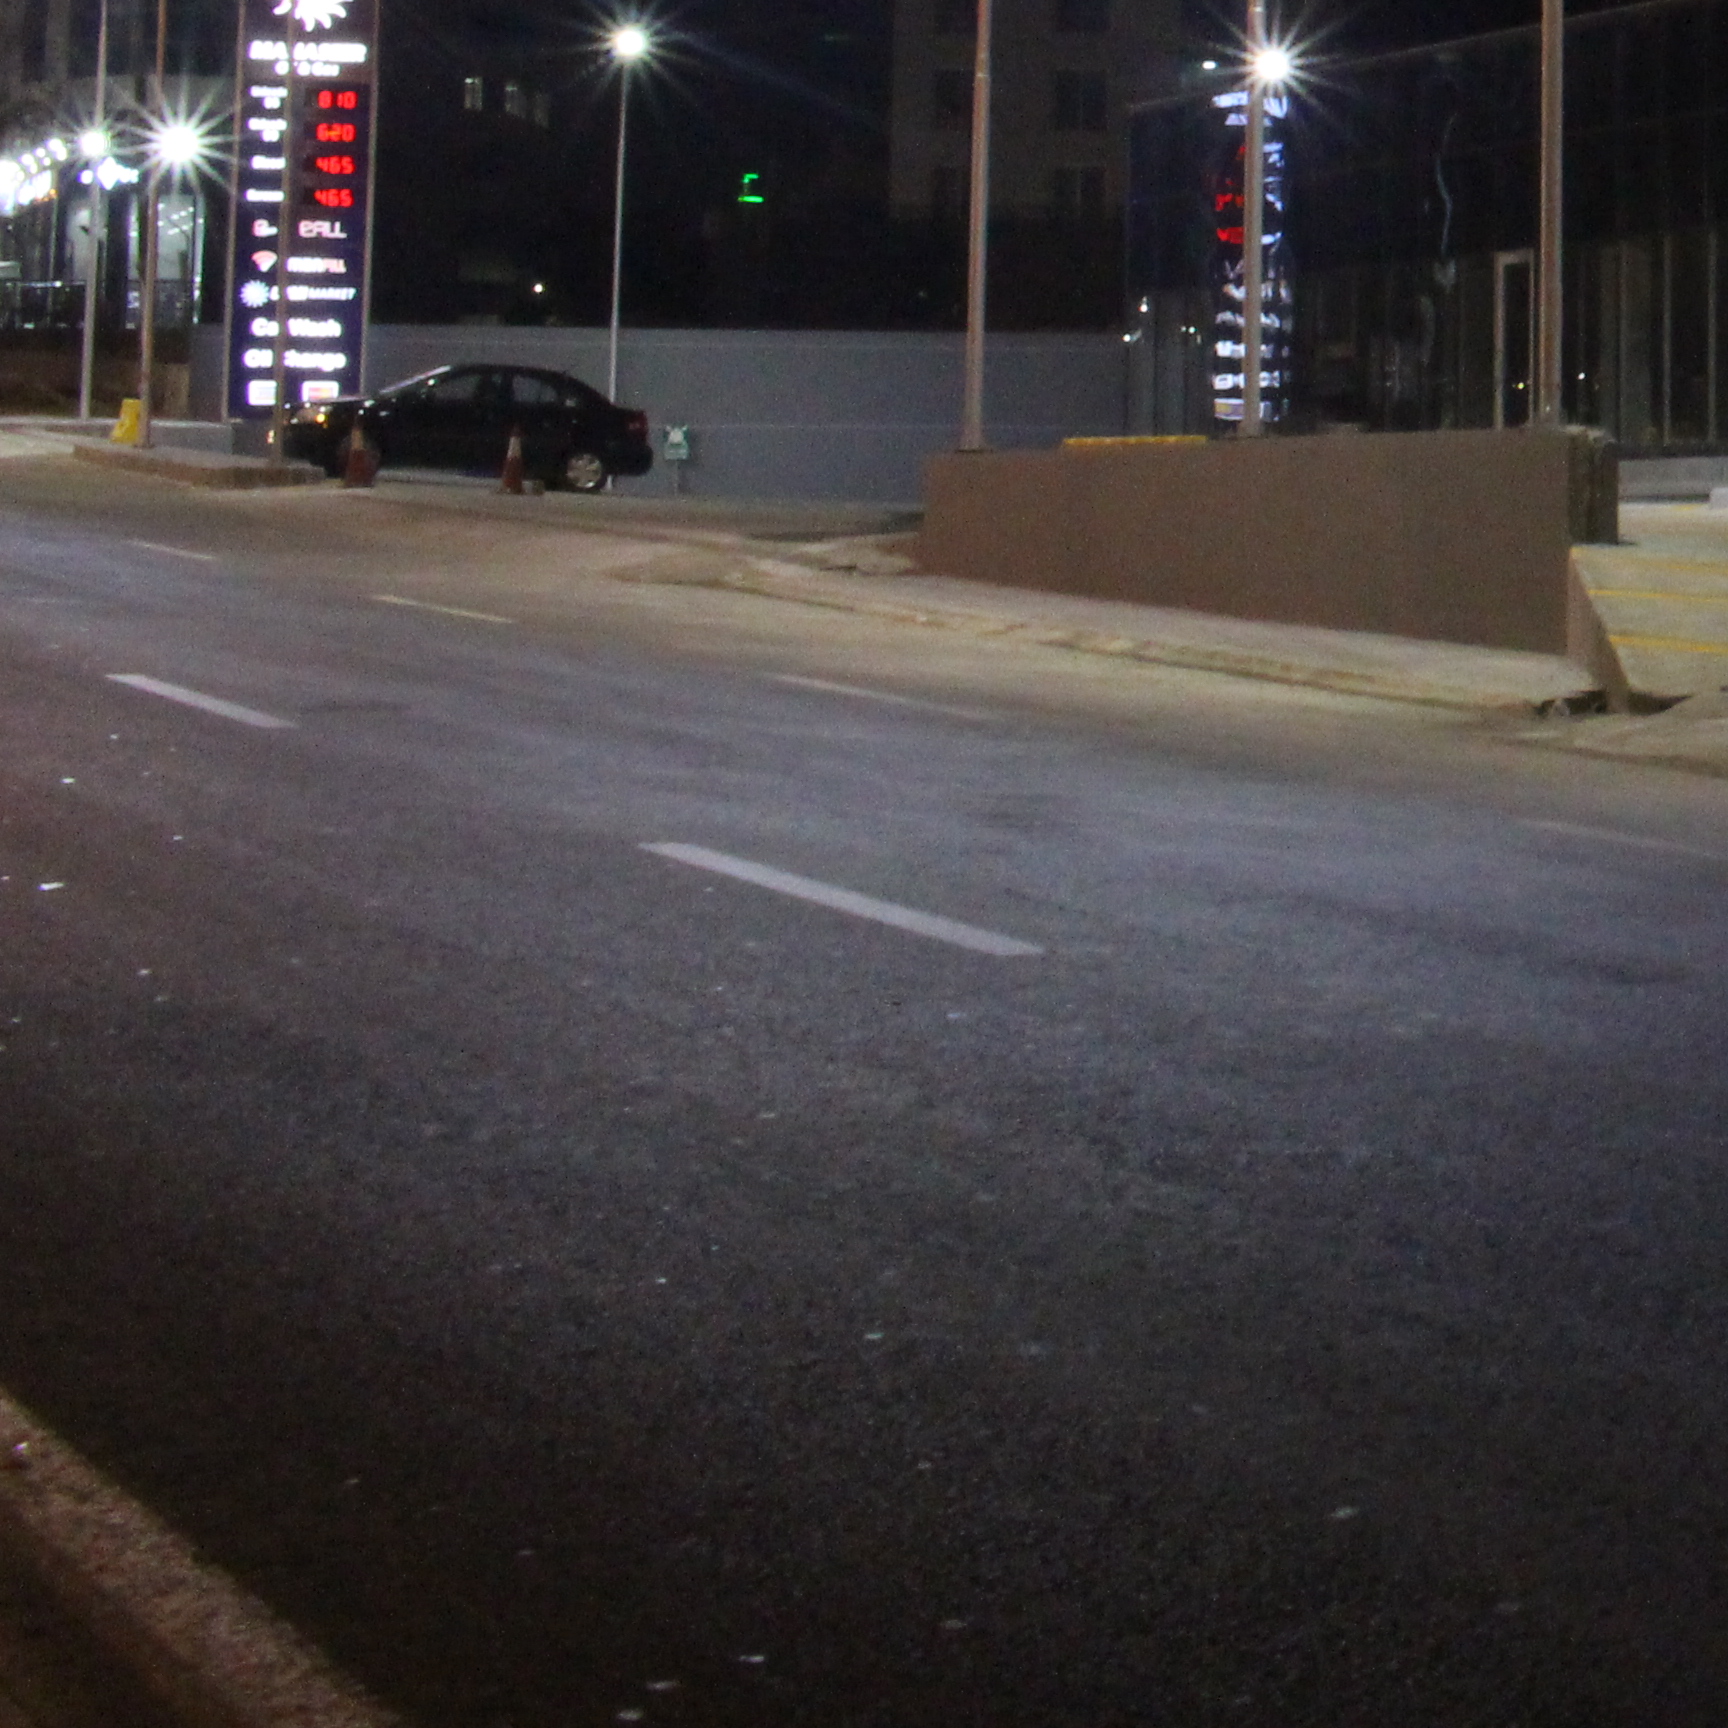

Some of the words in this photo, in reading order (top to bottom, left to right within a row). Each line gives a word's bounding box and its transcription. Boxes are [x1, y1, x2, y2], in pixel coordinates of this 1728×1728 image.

[316, 122, 356, 142] 620
[315, 155, 356, 174] 465
[314, 188, 355, 207] 465
